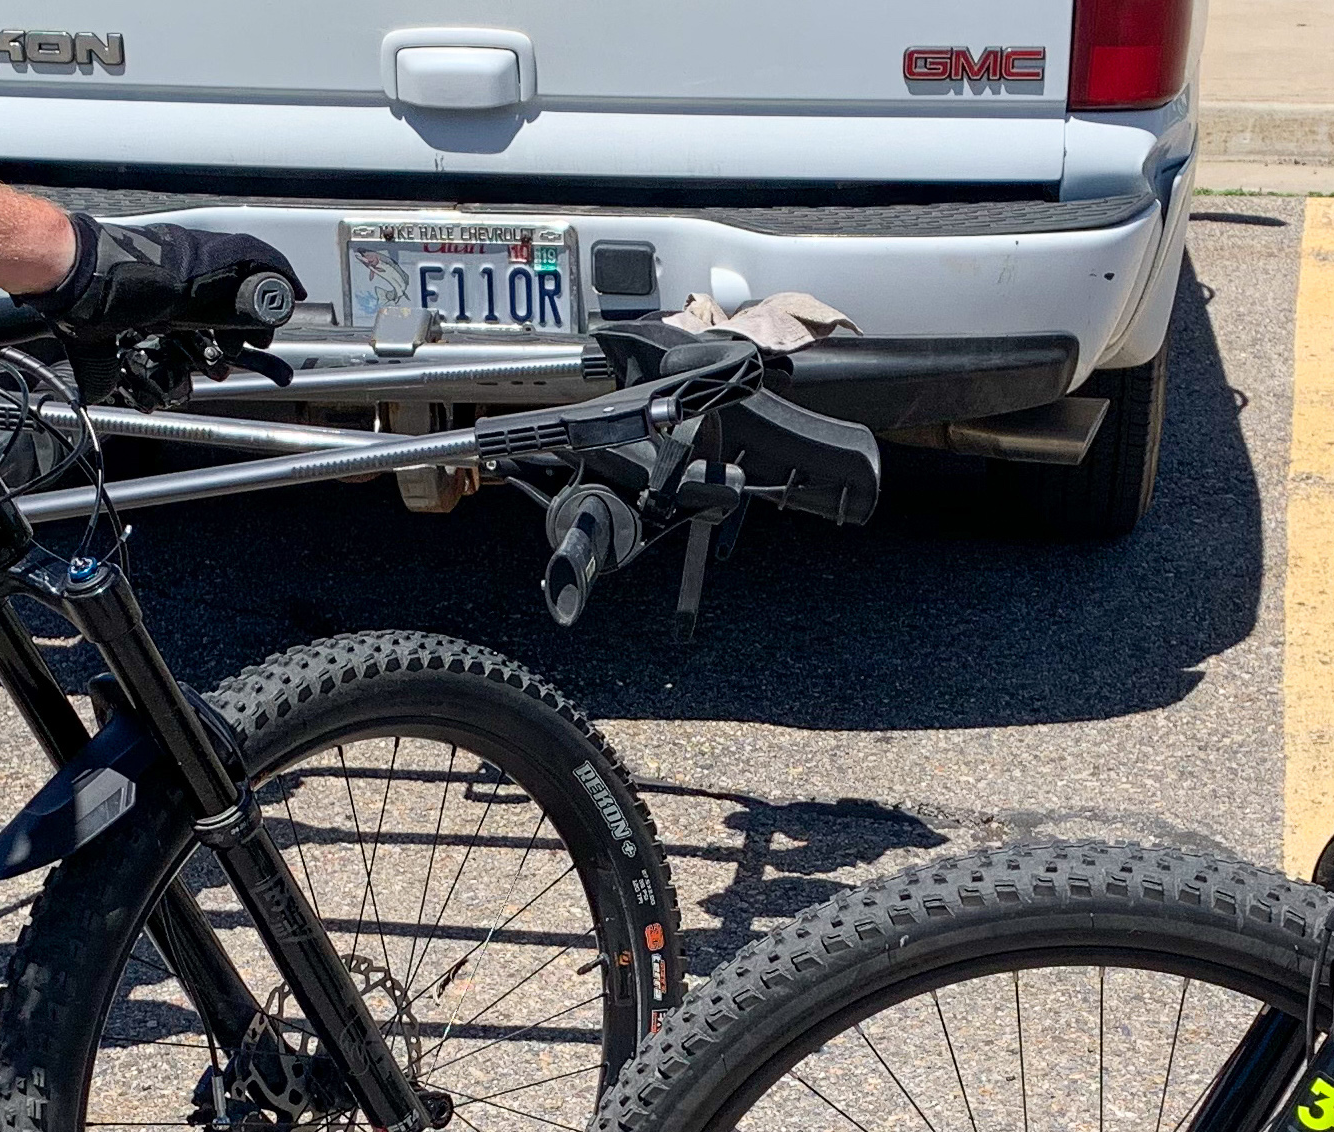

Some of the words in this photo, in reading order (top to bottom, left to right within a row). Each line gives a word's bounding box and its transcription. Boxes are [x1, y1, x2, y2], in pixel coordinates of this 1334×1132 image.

[903, 46, 1046, 81] GMC
[419, 226, 455, 242] HALE
[573, 760, 632, 840] REKON
